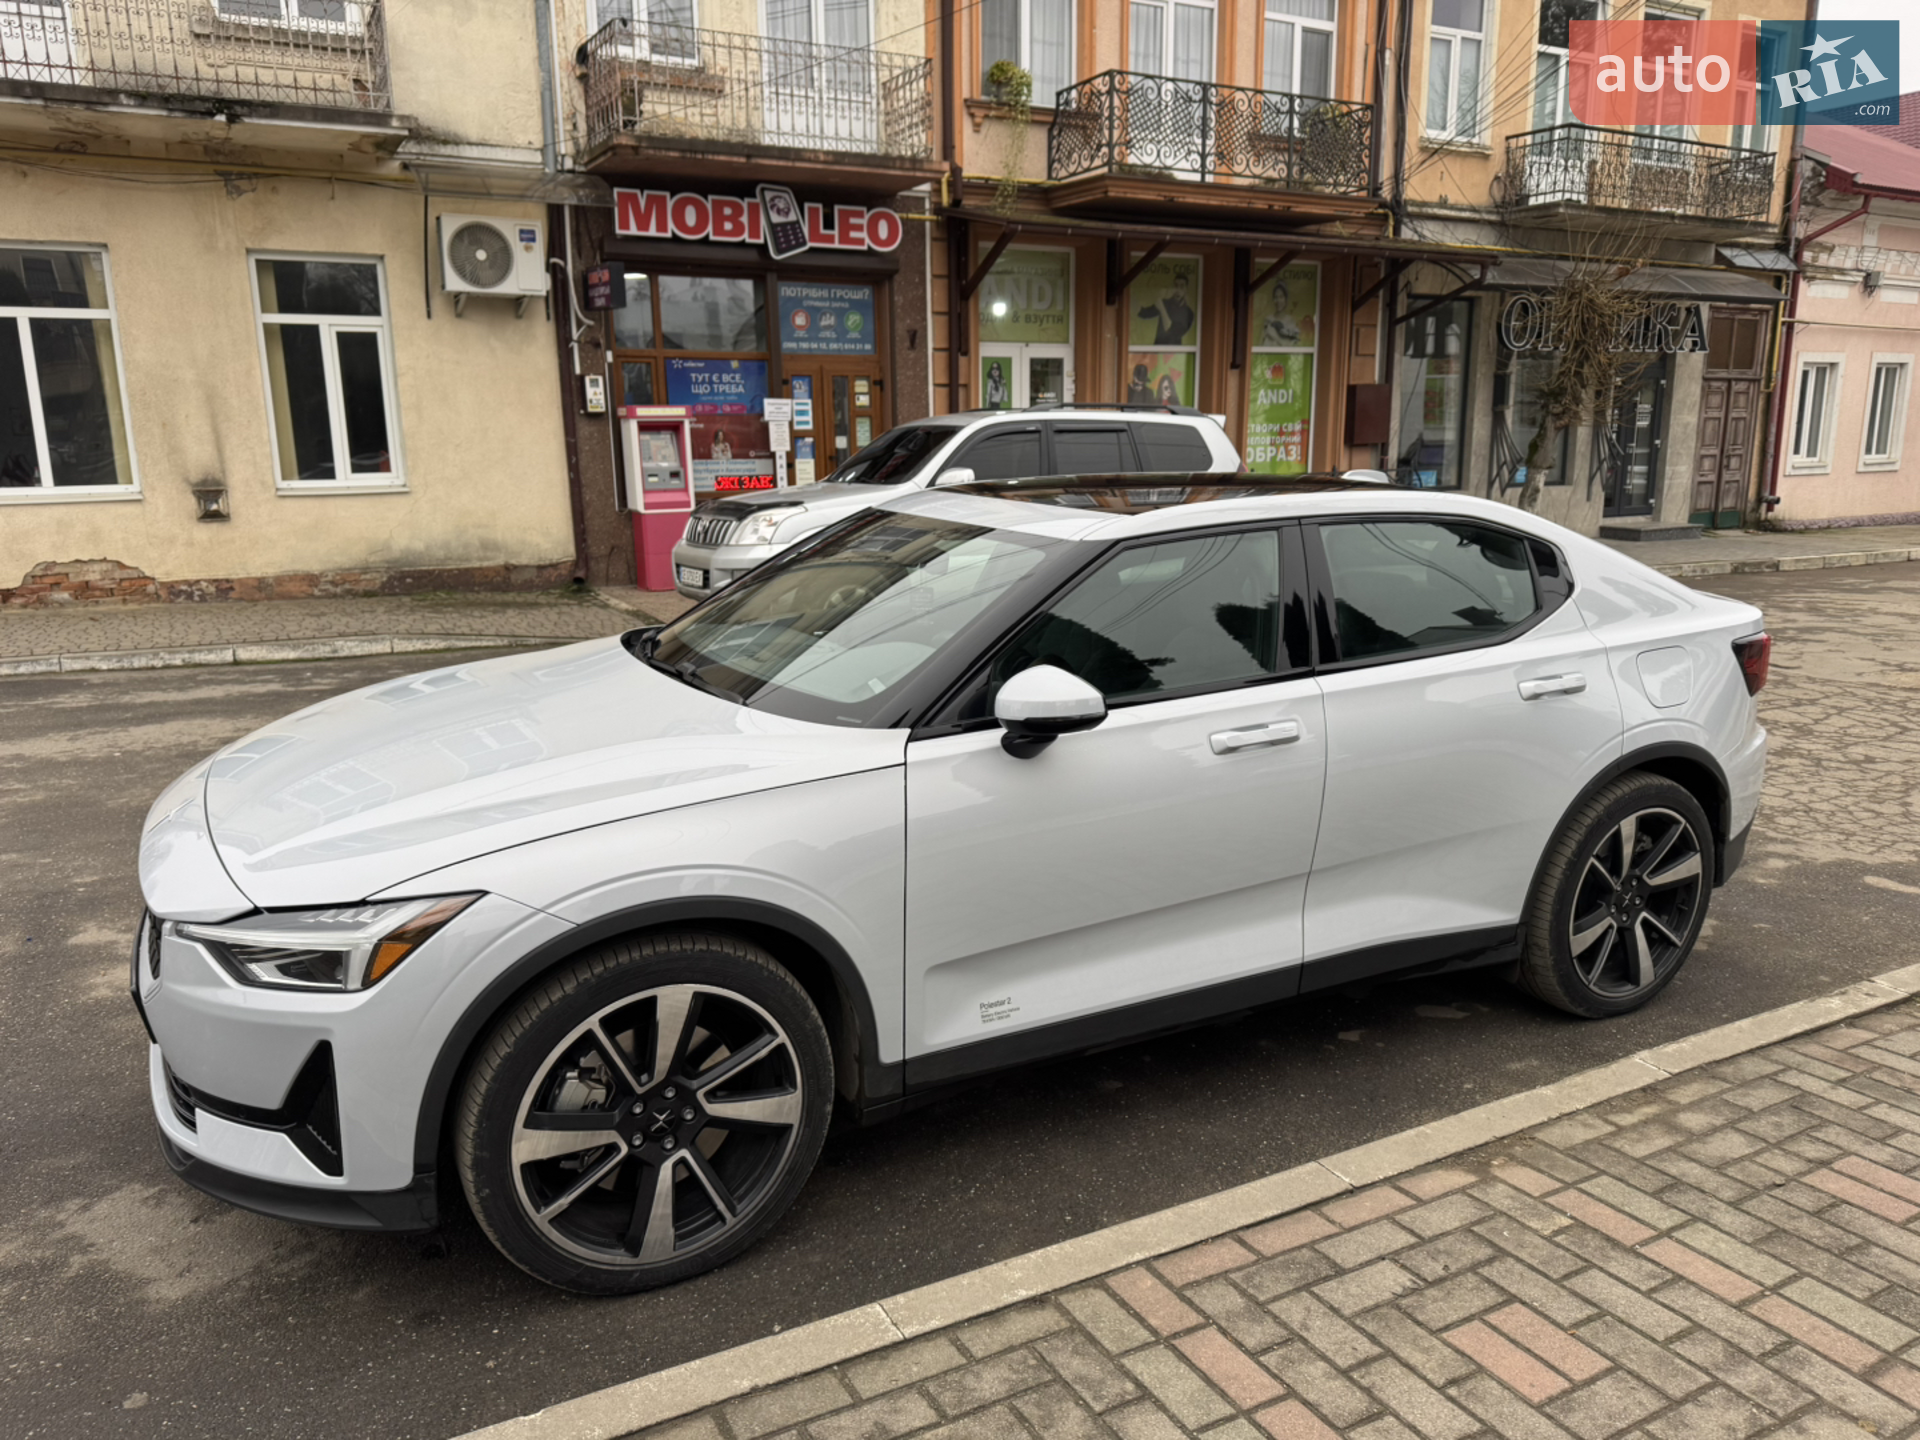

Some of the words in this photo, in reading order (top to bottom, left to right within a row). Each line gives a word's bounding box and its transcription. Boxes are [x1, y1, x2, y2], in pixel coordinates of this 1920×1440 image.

[613, 187, 764, 244] MOBI
[804, 202, 902, 252] LEO
[781, 287, 829, 298] ПОТРІБНІ
[831, 288, 869, 299] ГРОШІ?
[979, 275, 1064, 311] ANDI
[1025, 314, 1064, 327] взуття
[690, 373, 710, 382] ТУТ
[712, 373, 719, 383] Є
[722, 373, 745, 384] ВСЕ,
[691, 383, 710, 394] ЩО
[713, 384, 745, 393] ТРЕБА
[1257, 388, 1294, 405] ANDI
[1246, 445, 1302, 463] ОБРАЗ!
[980, 999, 1006, 1010] Polestar
[1007, 996, 1012, 1005] 2
